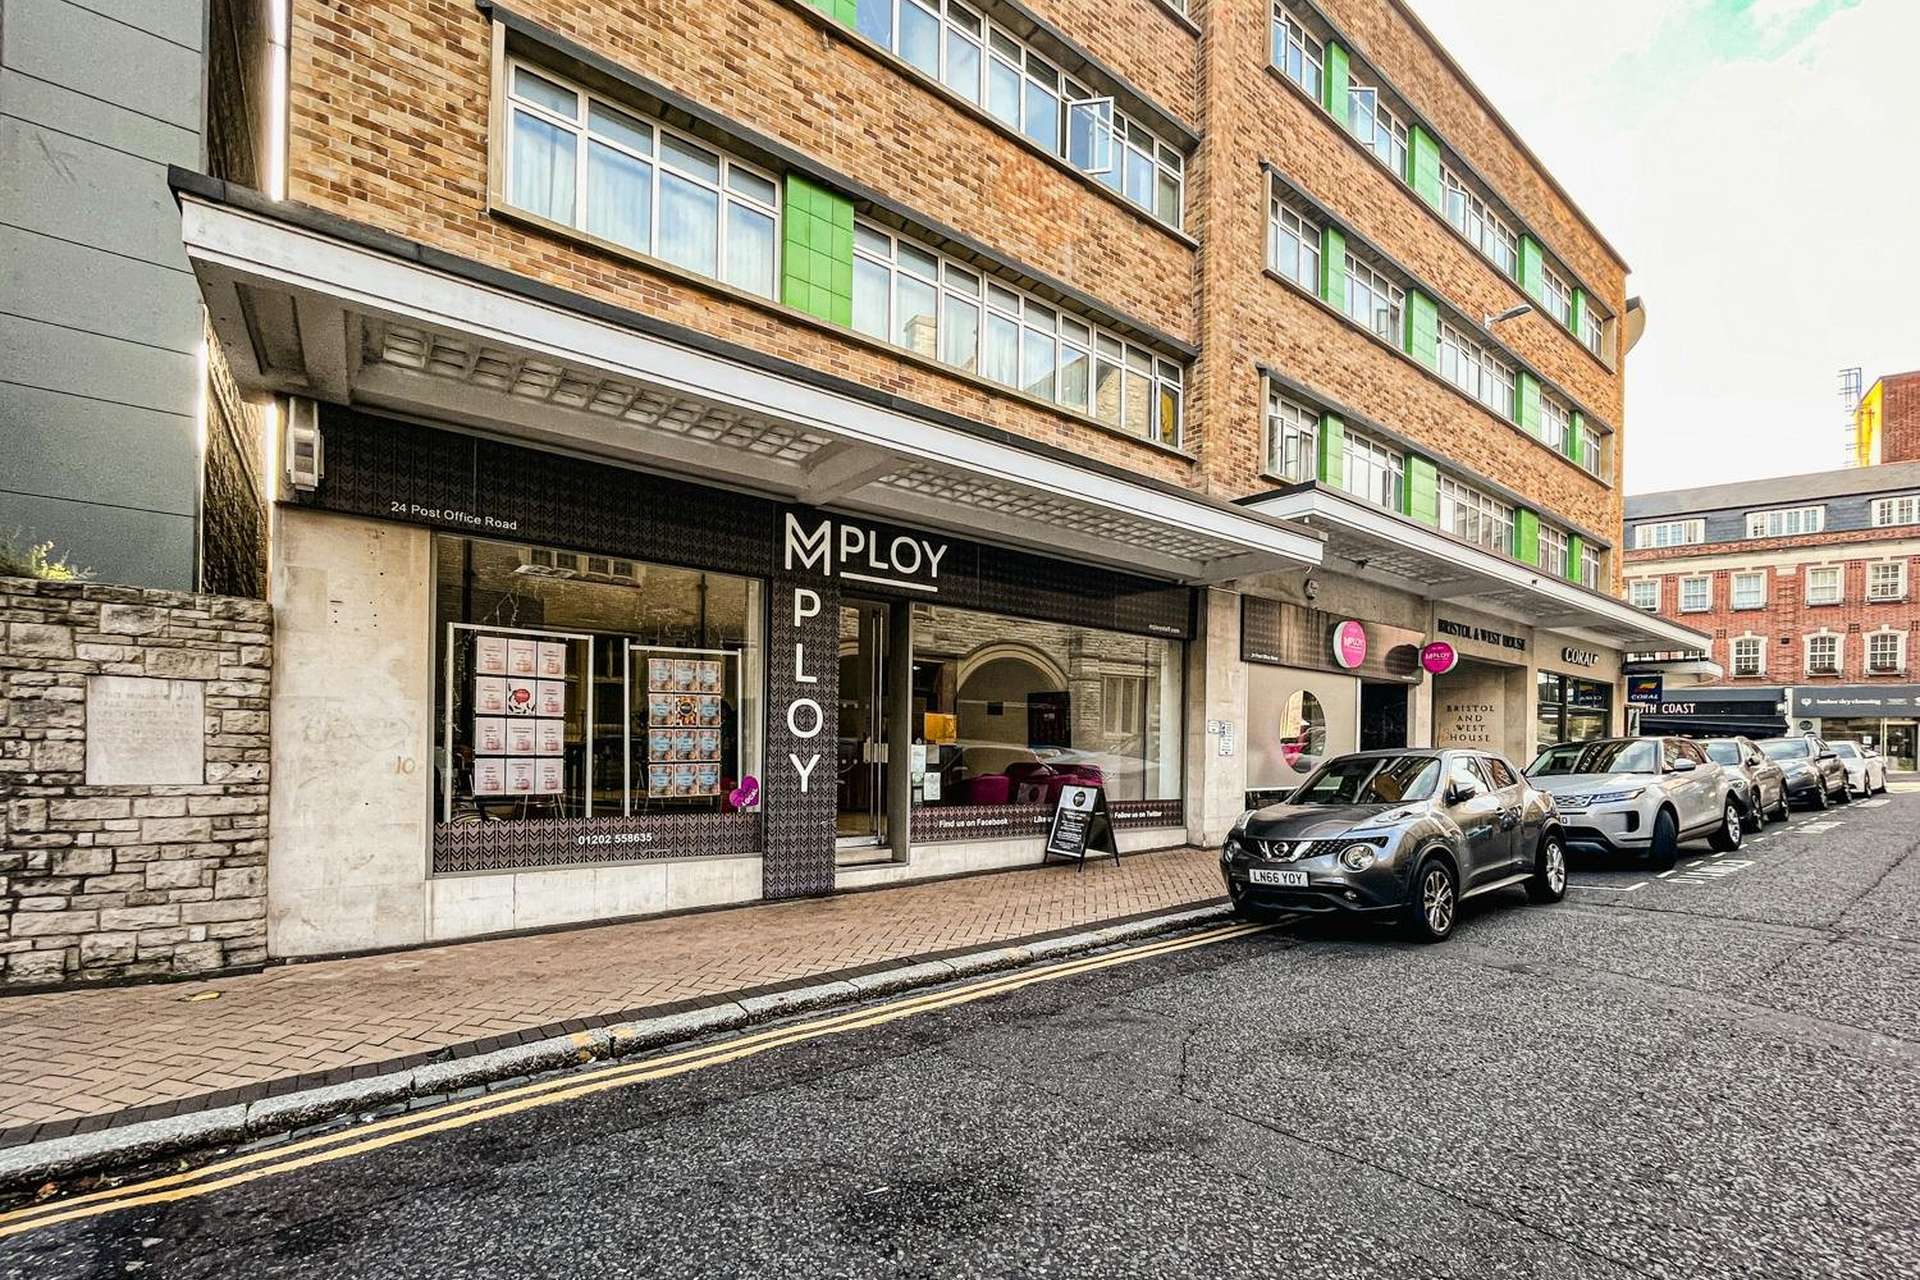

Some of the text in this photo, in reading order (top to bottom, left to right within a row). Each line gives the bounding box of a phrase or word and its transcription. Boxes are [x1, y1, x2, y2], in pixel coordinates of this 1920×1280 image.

[391, 501, 517, 530] 24 Post Office Road
[785, 512, 948, 578] MPLOY
[1438, 619, 1472, 639] BRISTOL
[1480, 628, 1502, 646] WEST
[1502, 634, 1526, 651] HOUSE
[1563, 647, 1598, 667] CORAL
[1446, 704, 1495, 712] BRISTOL
[1662, 703, 1696, 714] COAST
[1457, 714, 1483, 722] AND
[1455, 724, 1486, 732] WEST
[1450, 734, 1491, 742] HOUSE
[939, 820, 954, 828] Find
[977, 818, 1009, 826] Facebook
[578, 832, 653, 845] 01202 558635
[1253, 870, 1302, 885] LN66 YOY
